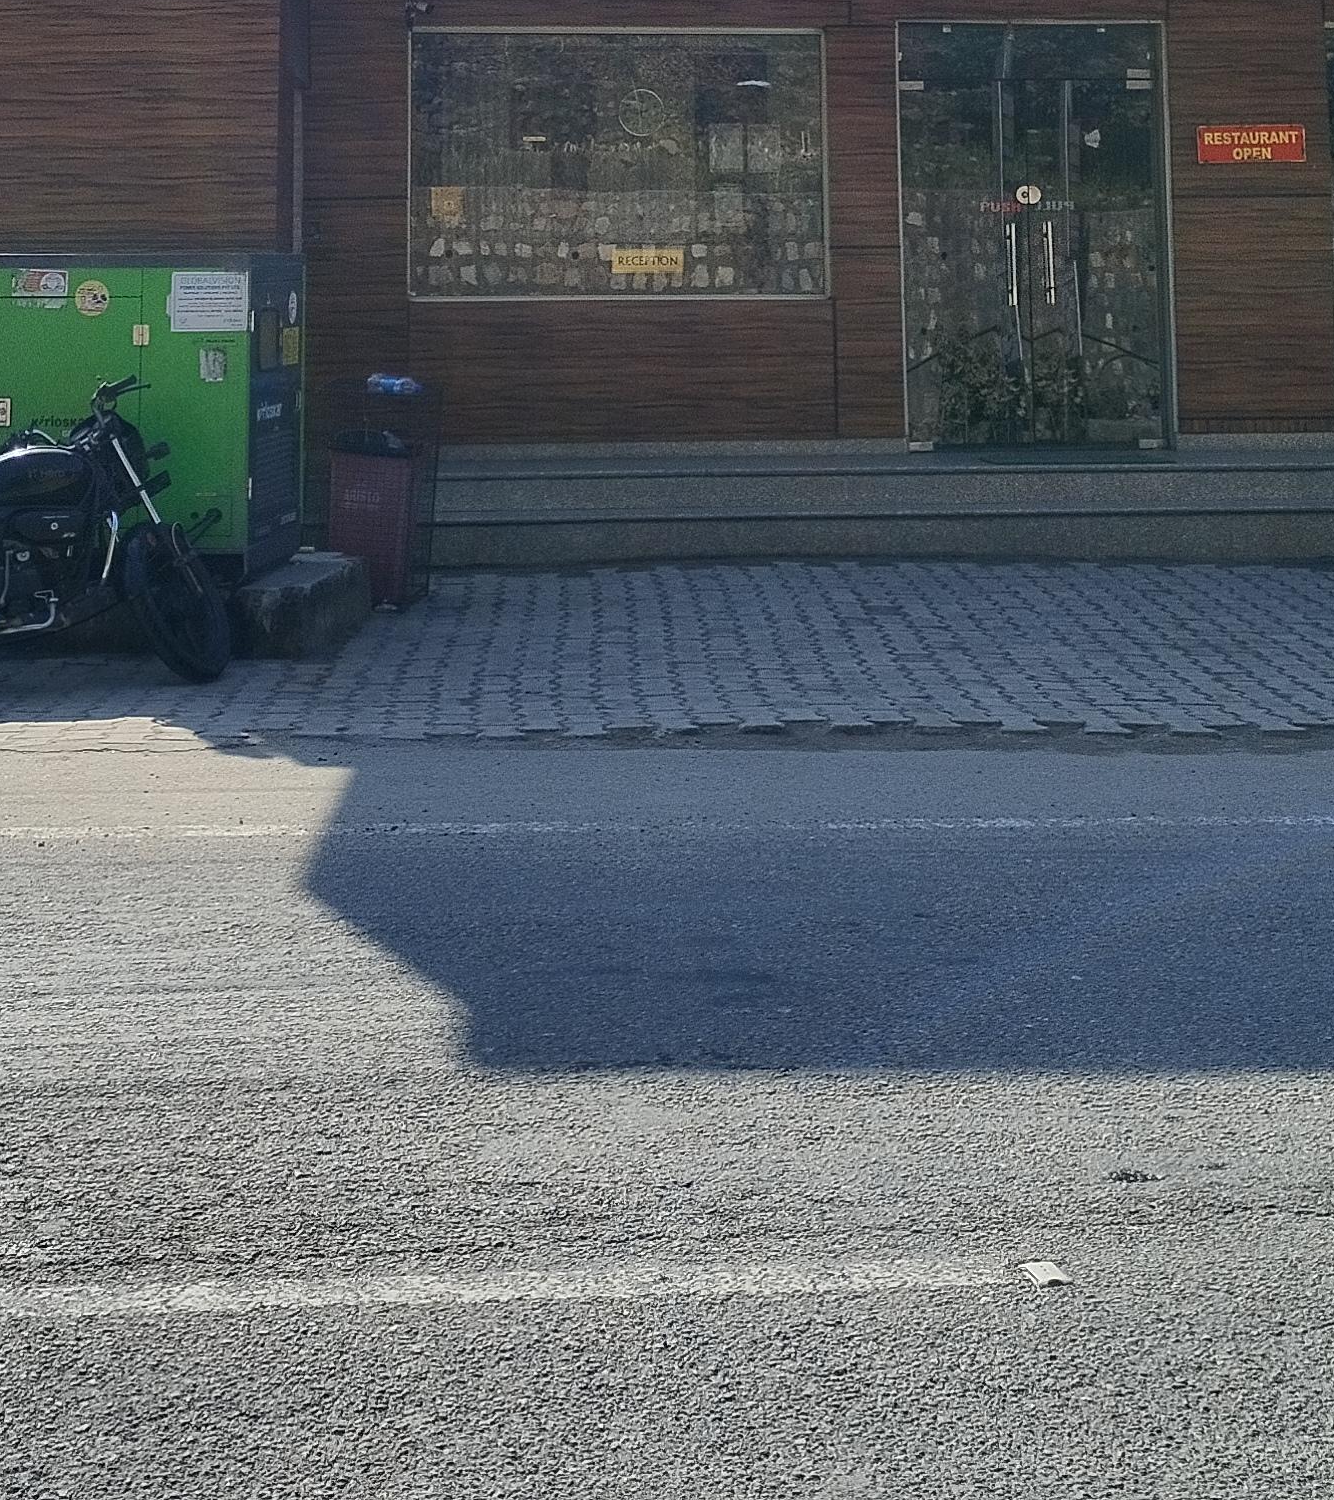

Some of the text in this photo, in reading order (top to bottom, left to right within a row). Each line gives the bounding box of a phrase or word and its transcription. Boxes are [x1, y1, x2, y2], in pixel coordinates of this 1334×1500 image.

[1203, 131, 1299, 145] RESTAURANT
[1232, 147, 1272, 160] OPEN
[979, 201, 1021, 213] PUSH
[618, 255, 678, 266] RECEPTION
